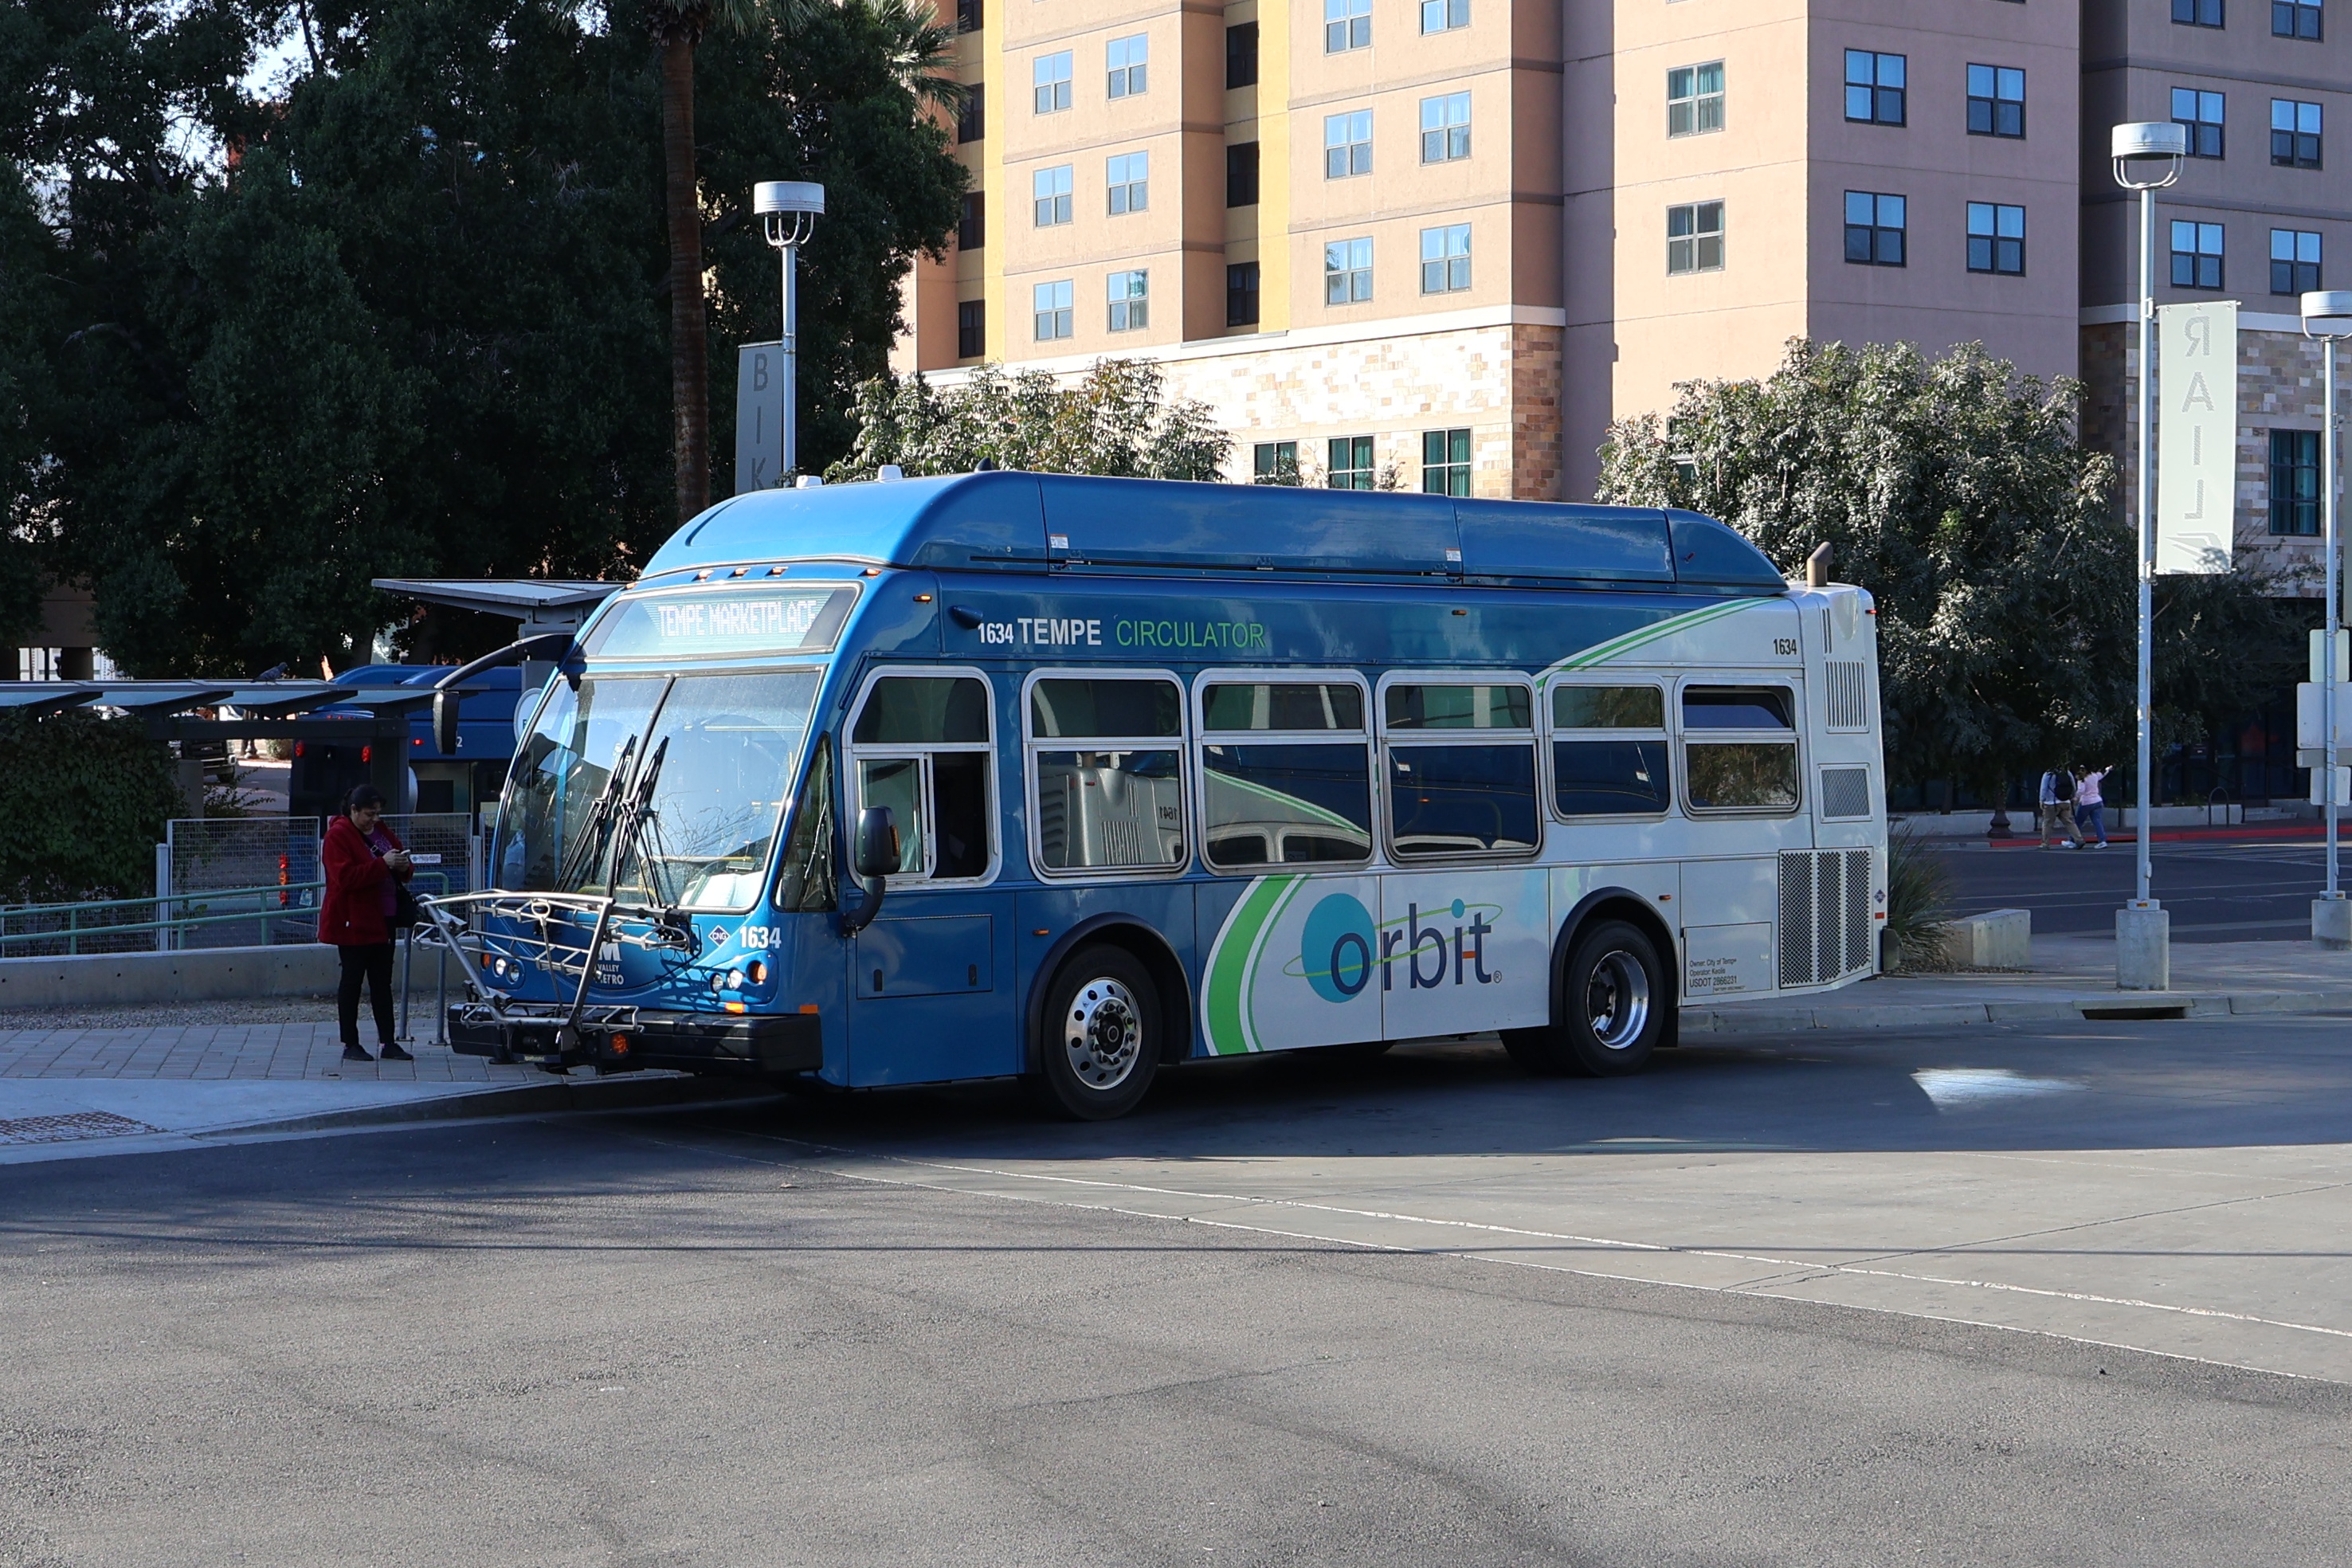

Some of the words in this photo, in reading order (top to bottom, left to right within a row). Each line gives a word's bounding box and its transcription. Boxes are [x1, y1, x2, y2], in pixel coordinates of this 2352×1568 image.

[657, 604, 706, 637] TEMPE
[708, 600, 819, 636] MARKETPLACE
[977, 622, 1013, 645] 1634
[1017, 617, 1102, 646] TEMPE
[1116, 620, 1266, 649] CIRCULATOR
[1773, 638, 1797, 655] 1634
[711, 931, 727, 941] CNG
[739, 926, 782, 949] 1634
[1331, 898, 1492, 995] orbit
[597, 963, 620, 972] VALLEY
[599, 974, 624, 985] ETRO
[1689, 977, 1711, 987] USDOT
